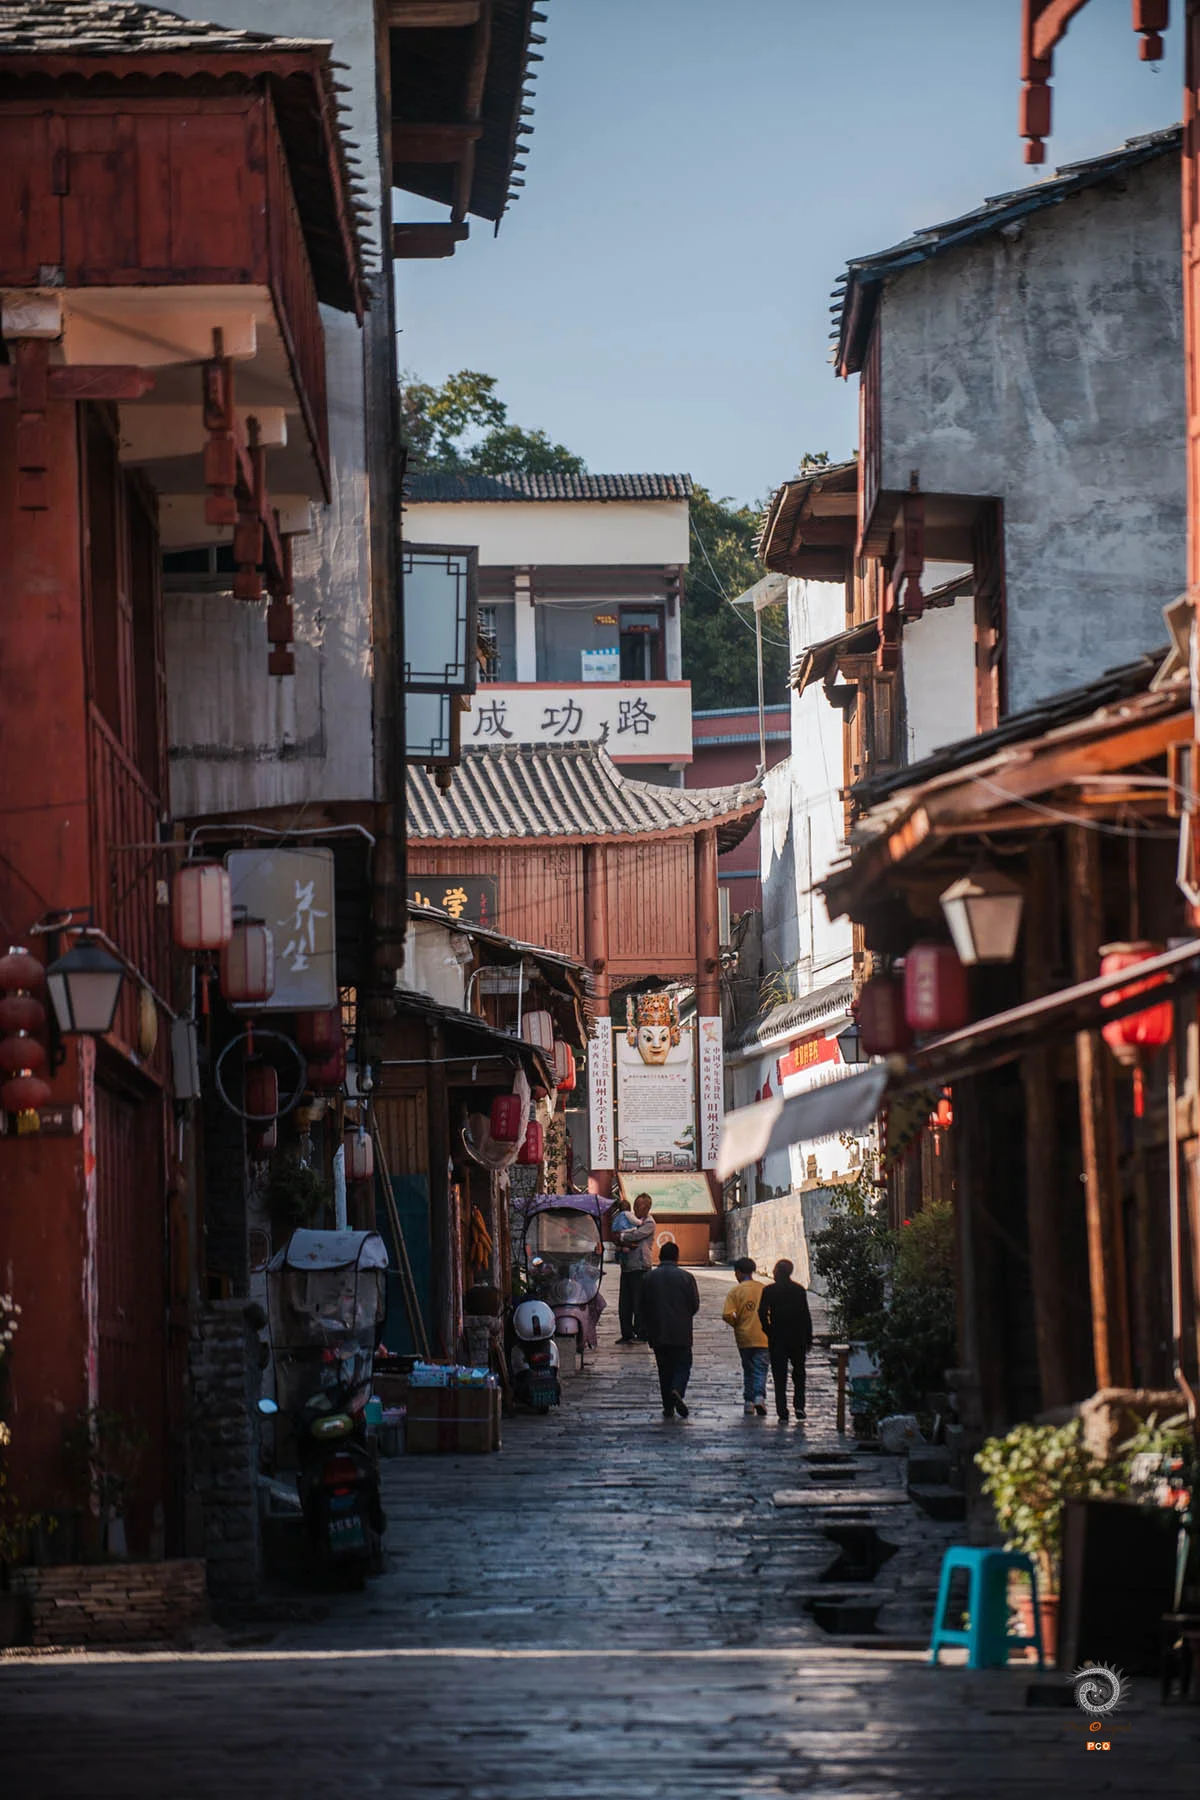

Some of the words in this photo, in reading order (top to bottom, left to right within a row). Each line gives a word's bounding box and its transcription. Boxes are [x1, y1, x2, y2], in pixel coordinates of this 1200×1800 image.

[473, 696, 657, 737] 成功路
[595, 1078, 608, 1162] 旧州小学工作委员会
[707, 1103, 720, 1161] 旧州小学大队
